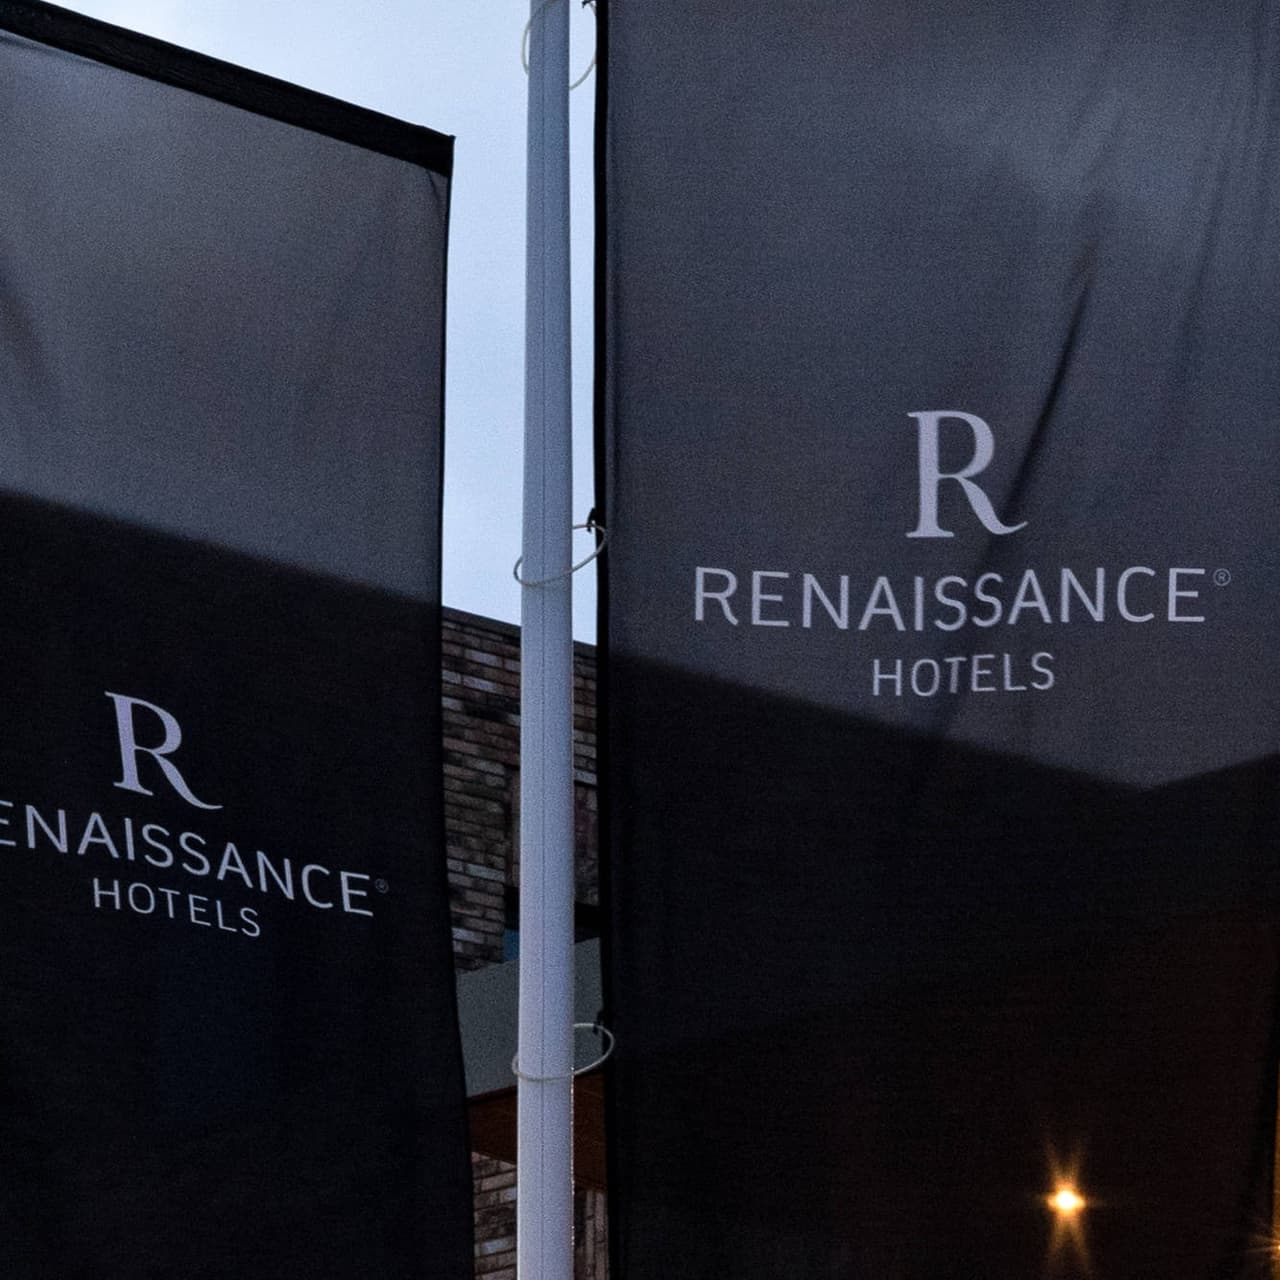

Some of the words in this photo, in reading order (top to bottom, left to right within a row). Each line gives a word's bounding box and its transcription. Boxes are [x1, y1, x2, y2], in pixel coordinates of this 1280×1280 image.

[906, 410, 1028, 538] R
[872, 651, 1055, 697] HOTELS
[104, 691, 223, 810] R
[93, 877, 261, 937] HOTELS
